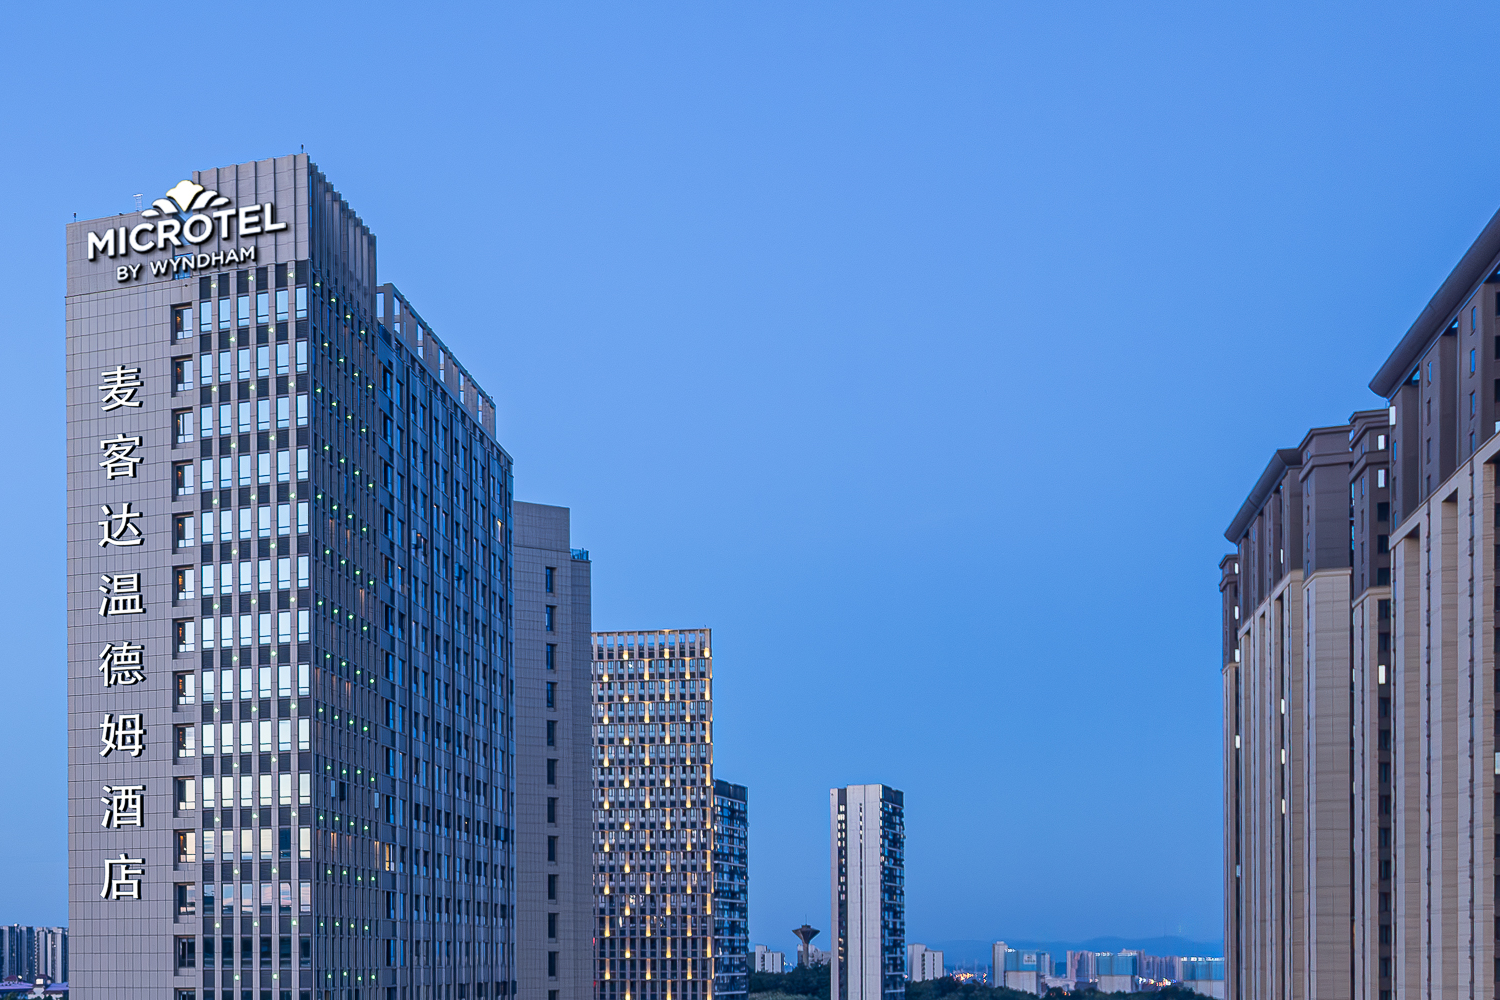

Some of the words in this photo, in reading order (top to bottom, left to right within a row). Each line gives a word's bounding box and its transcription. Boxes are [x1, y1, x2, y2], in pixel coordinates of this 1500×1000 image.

[87, 202, 287, 260] MICROTEL
[116, 263, 141, 282] BY
[149, 246, 256, 277] WYNDHAM
[98, 364, 145, 901] 麦客达温德姆酒店
